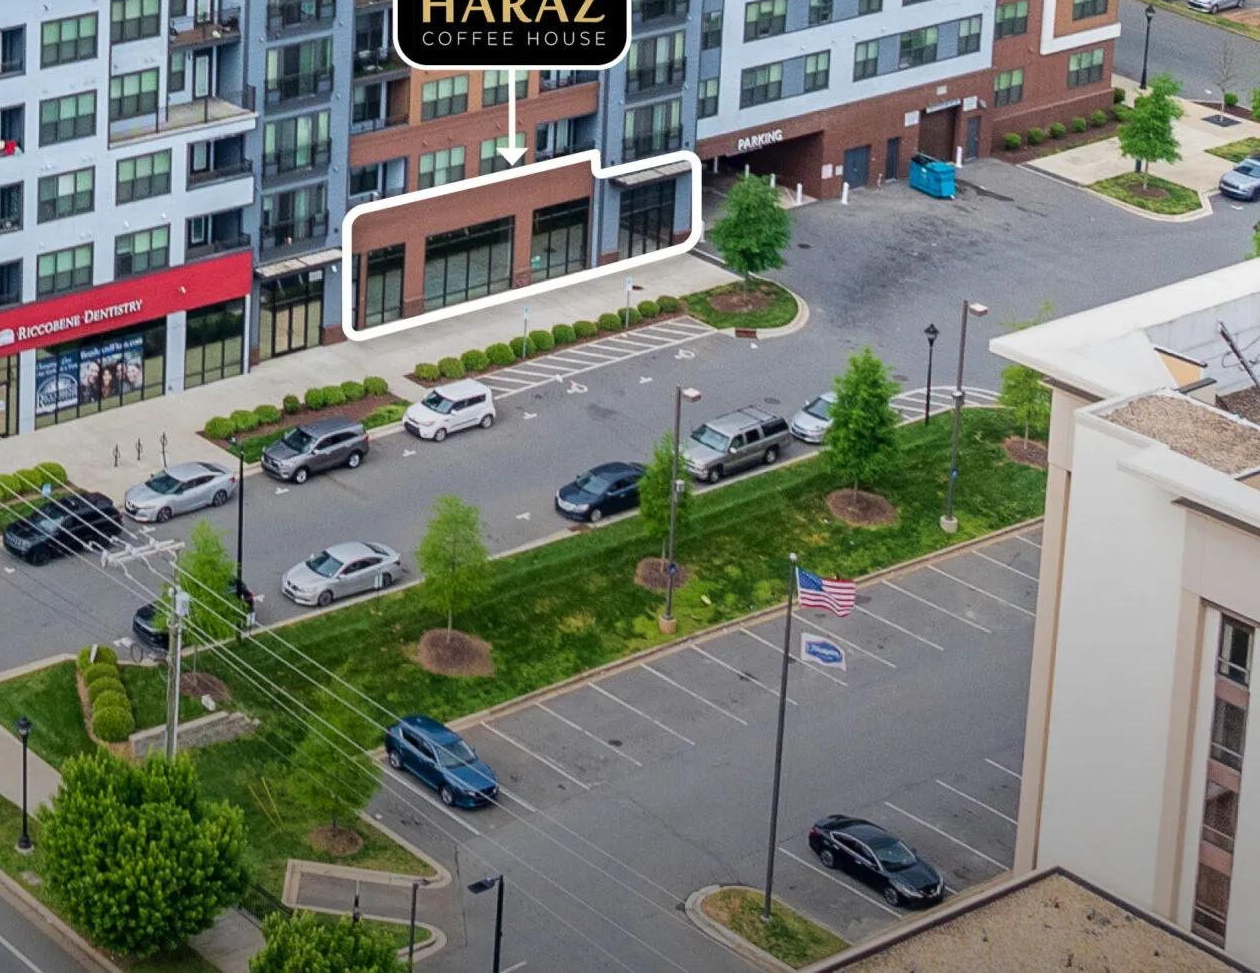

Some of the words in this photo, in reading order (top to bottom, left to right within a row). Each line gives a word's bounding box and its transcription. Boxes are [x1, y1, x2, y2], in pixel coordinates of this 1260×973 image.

[738, 129, 783, 151] PARKING
[17, 314, 81, 341] RICCOBENE
[84, 299, 143, 325] DENTISTRY
